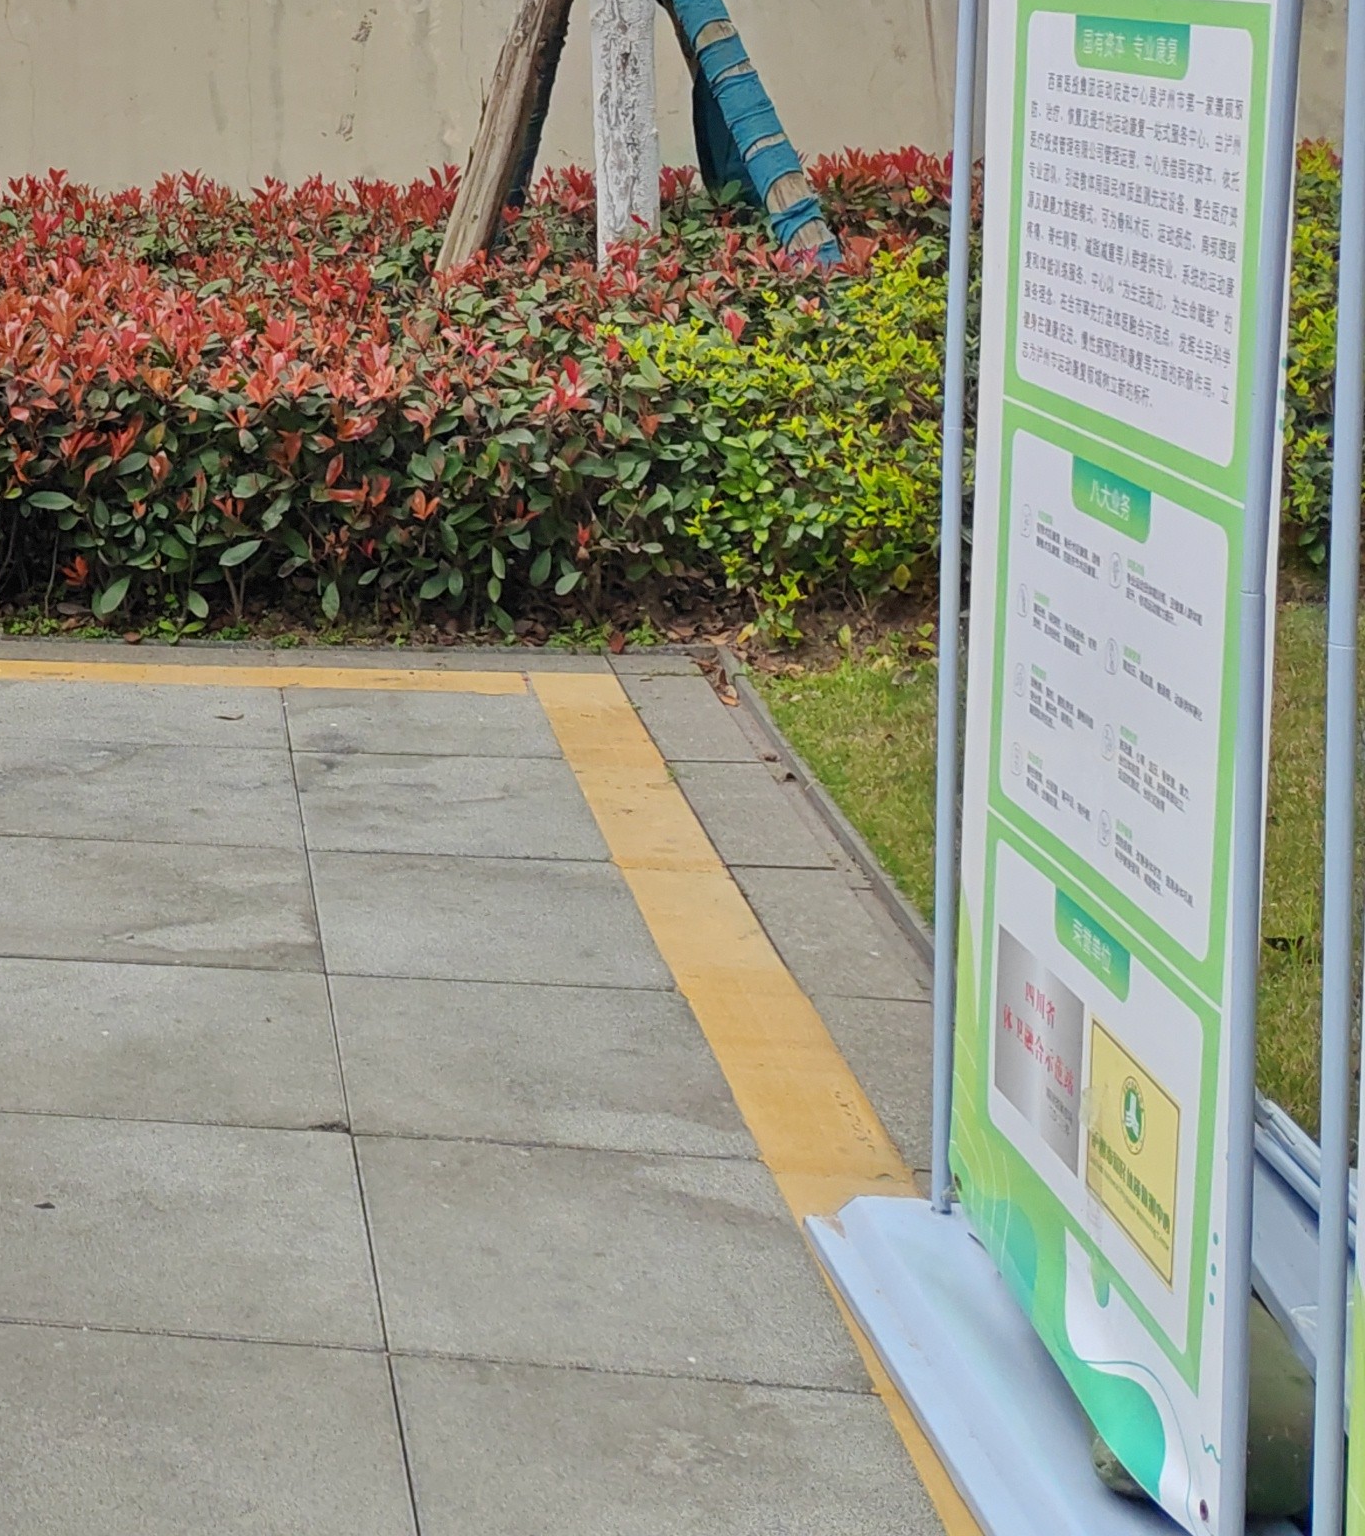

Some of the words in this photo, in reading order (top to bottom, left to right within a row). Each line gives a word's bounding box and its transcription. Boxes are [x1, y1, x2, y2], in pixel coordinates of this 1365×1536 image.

[1089, 477, 1131, 521] 八大业务
[1025, 980, 1056, 1029] 四川省
